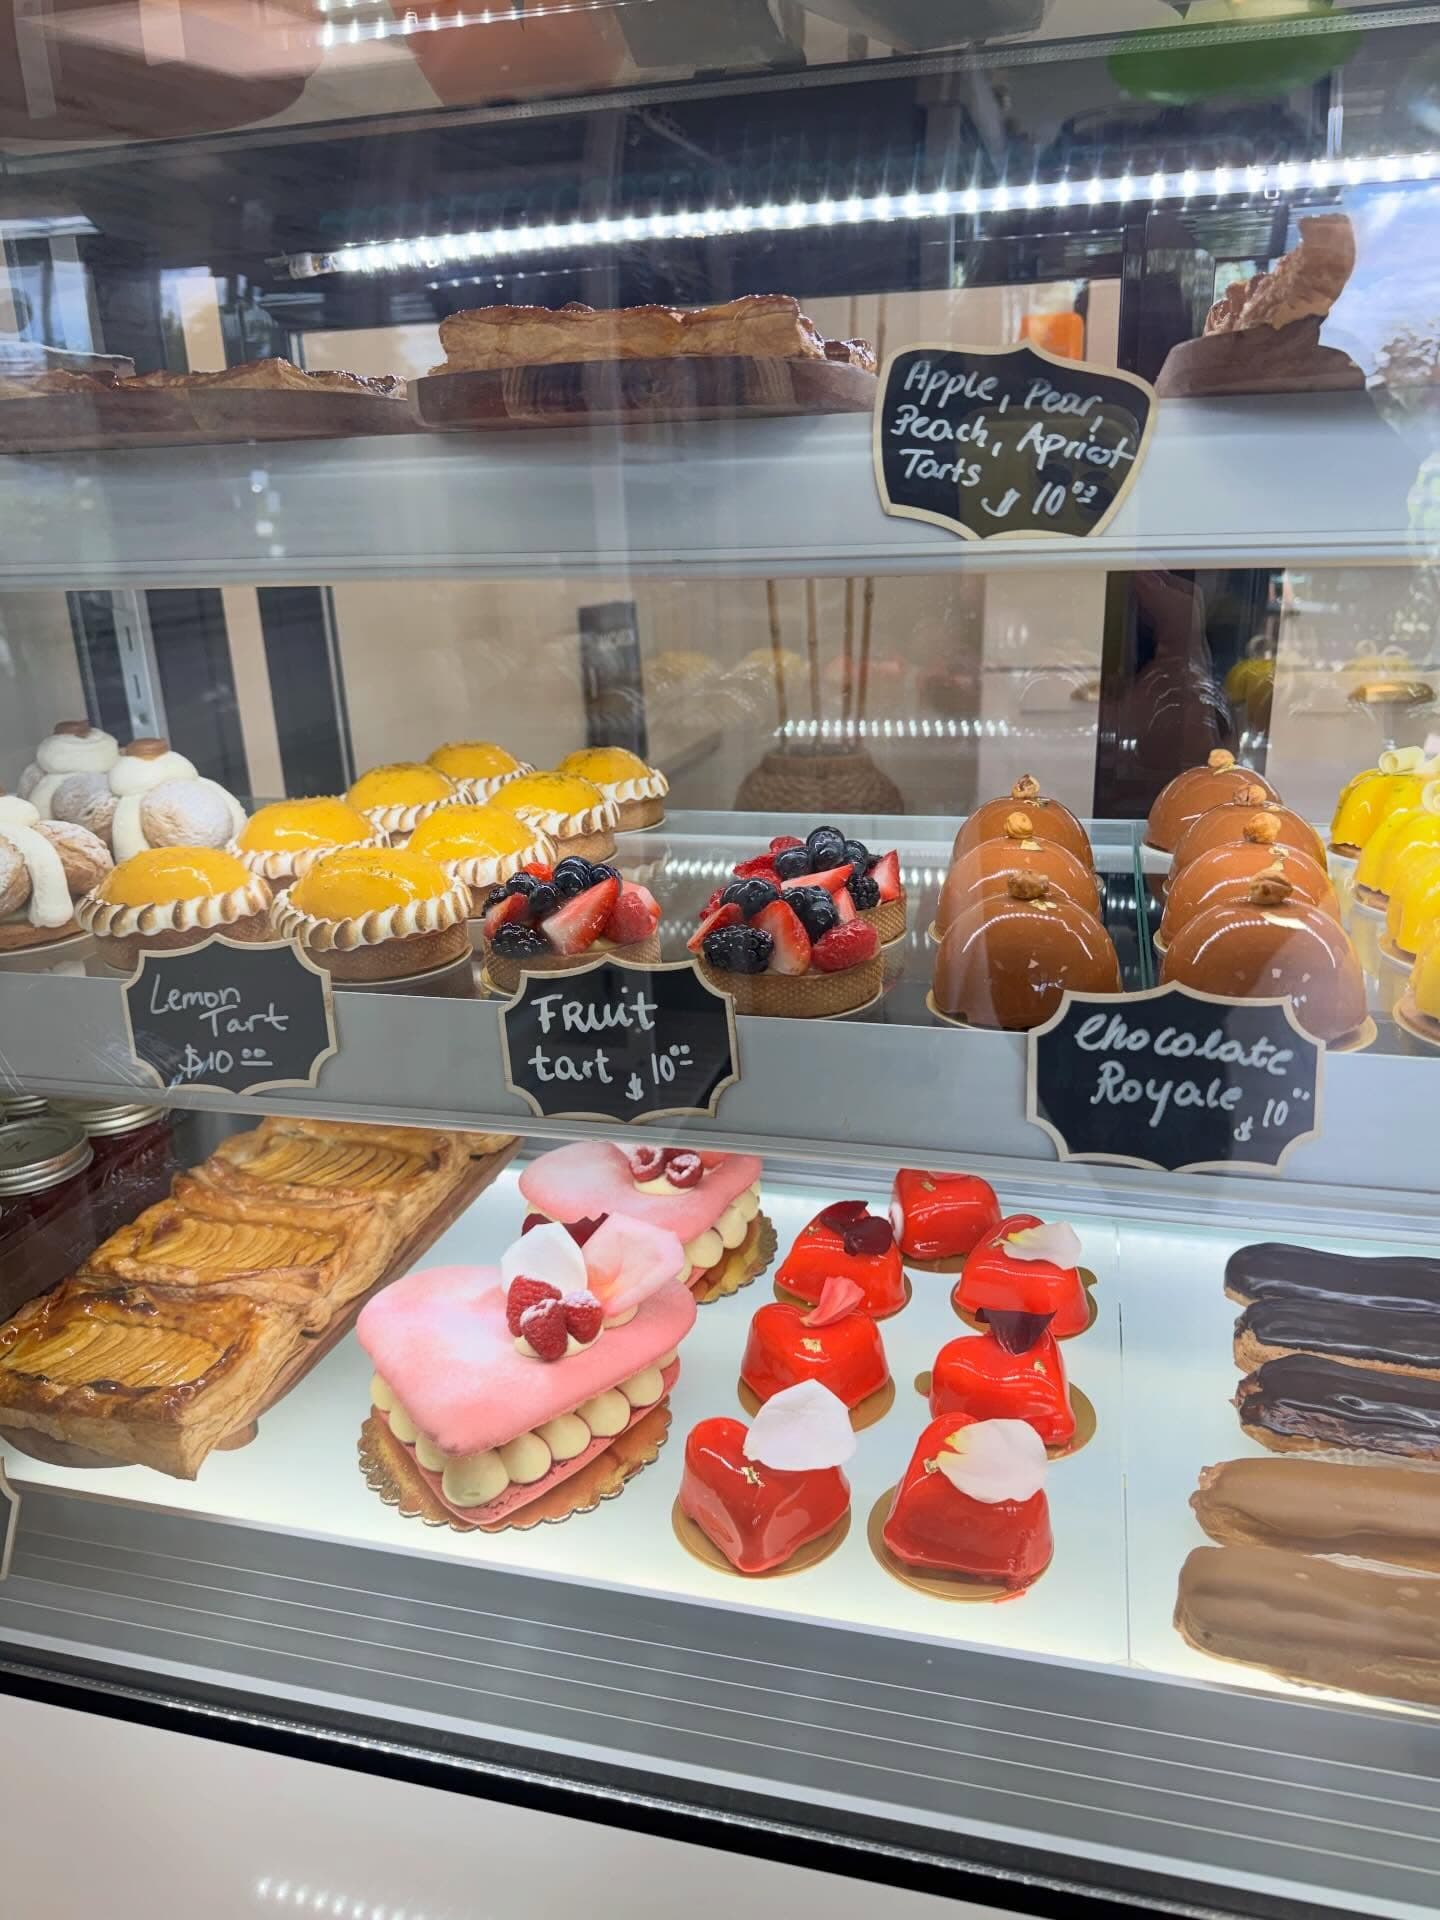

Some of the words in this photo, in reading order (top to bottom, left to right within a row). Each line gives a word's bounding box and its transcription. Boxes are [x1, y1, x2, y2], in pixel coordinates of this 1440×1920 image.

[903, 360, 1010, 413] Apple,
[899, 448, 981, 487] Tarts
[150, 973, 241, 1014] Lemon
[198, 1002, 289, 1038] Tart
[527, 1045, 613, 1084] tart
[1074, 1013, 1294, 1075] Chocolate
[1090, 1060, 1243, 1128] Royale
